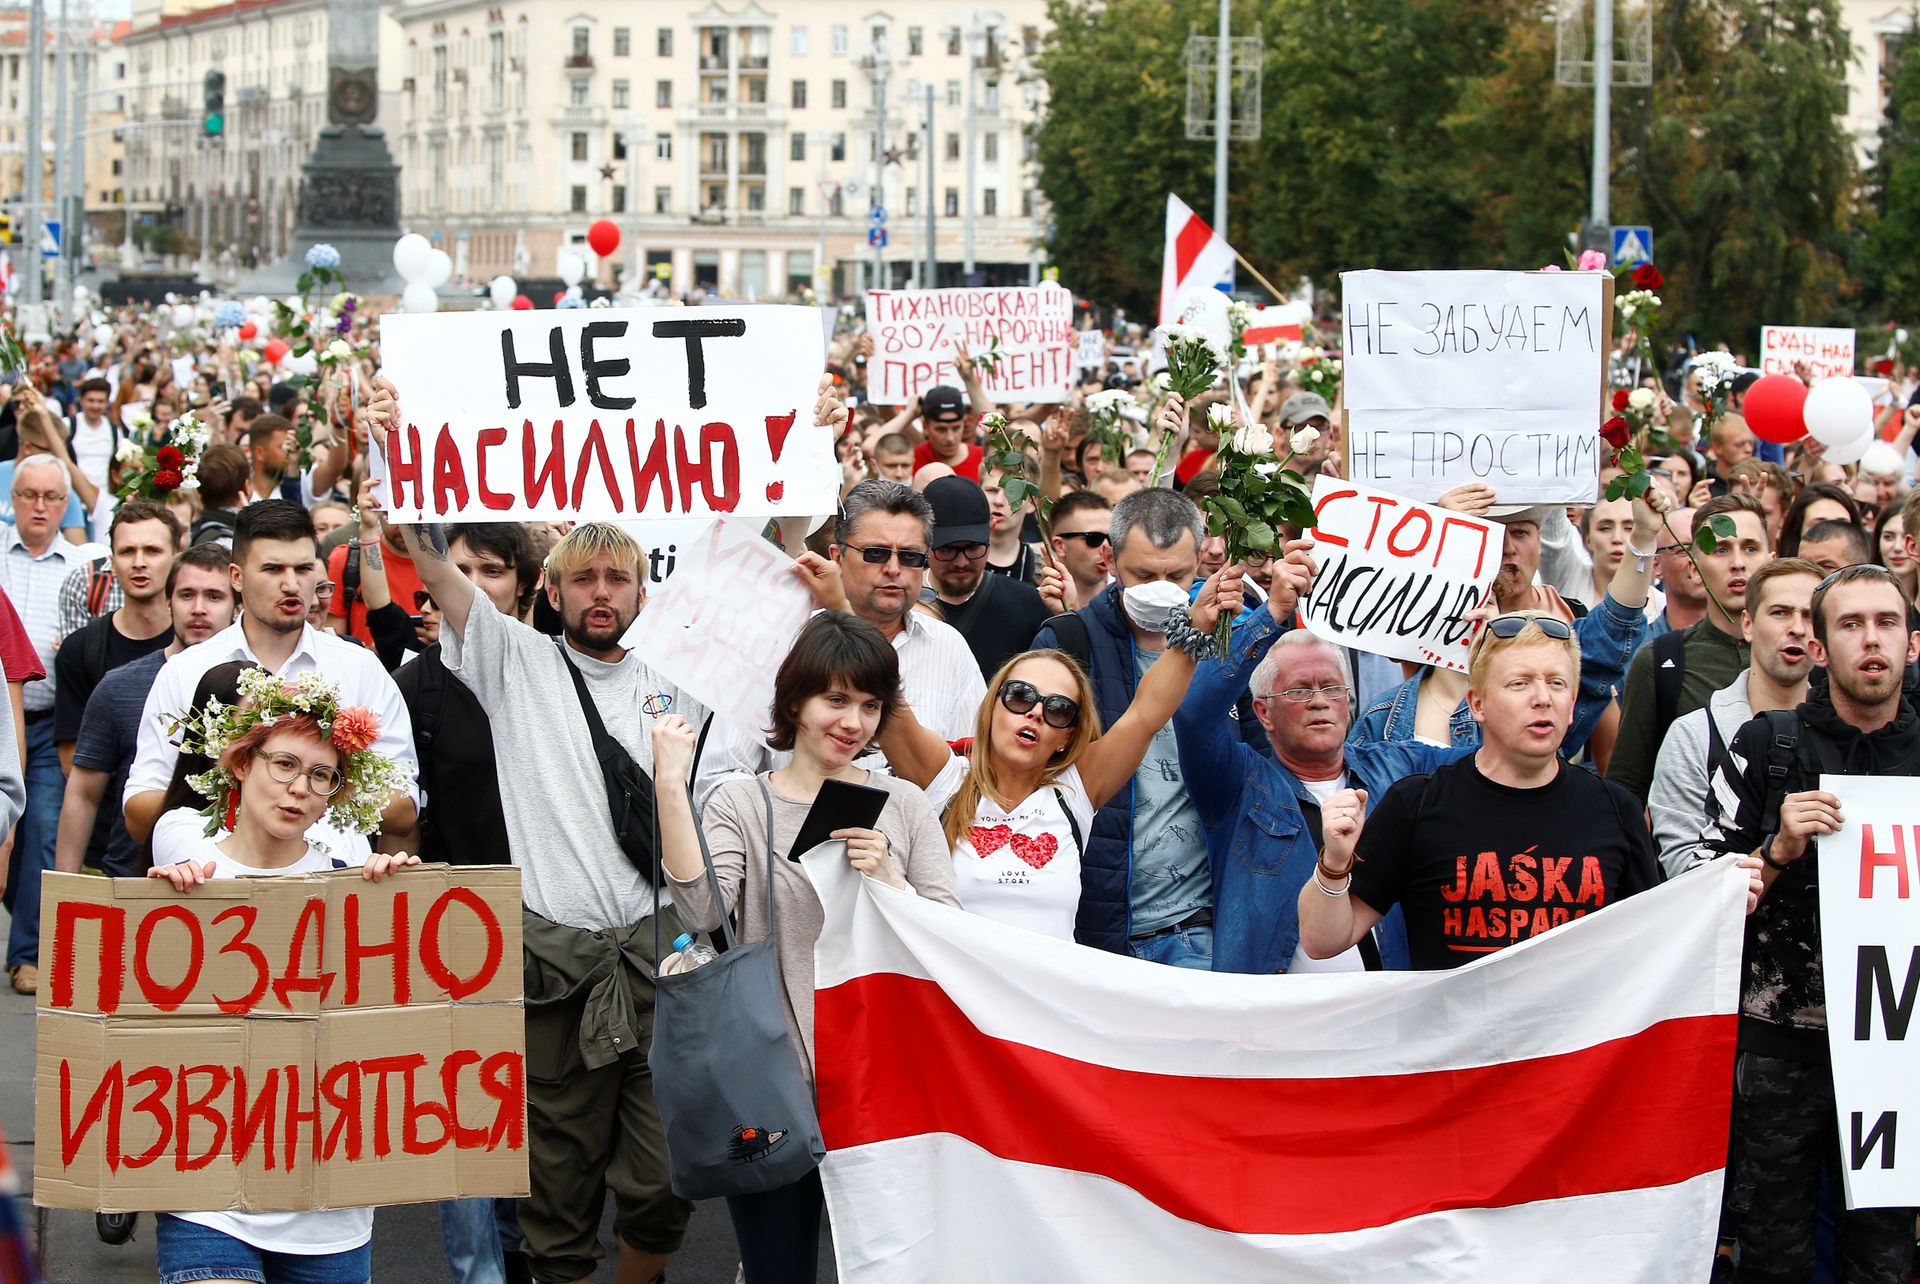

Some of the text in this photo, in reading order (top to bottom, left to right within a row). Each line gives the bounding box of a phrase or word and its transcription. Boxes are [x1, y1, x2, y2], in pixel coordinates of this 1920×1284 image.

[881, 322, 950, 353] 80%
[965, 318, 1073, 346] НАРОДНЫ
[1348, 302, 1595, 355] НЕ ЗАБУДЕМ
[1766, 329, 1816, 356] СУДЫ
[501, 319, 746, 409] НЕТ
[884, 347, 1072, 399] ПРЕИДЕНТ!
[1351, 431, 1597, 479] НЕ ПРОСТИМ
[1311, 490, 1489, 579] СТОП
[1440, 844, 1605, 907] JAŚKA
[1858, 823, 1920, 899] Н
[50, 886, 504, 1015] ПОЗДНО
[60, 1049, 525, 1176] ИЗВИНЯТЬСЯ
[1851, 1111, 1898, 1170] И
